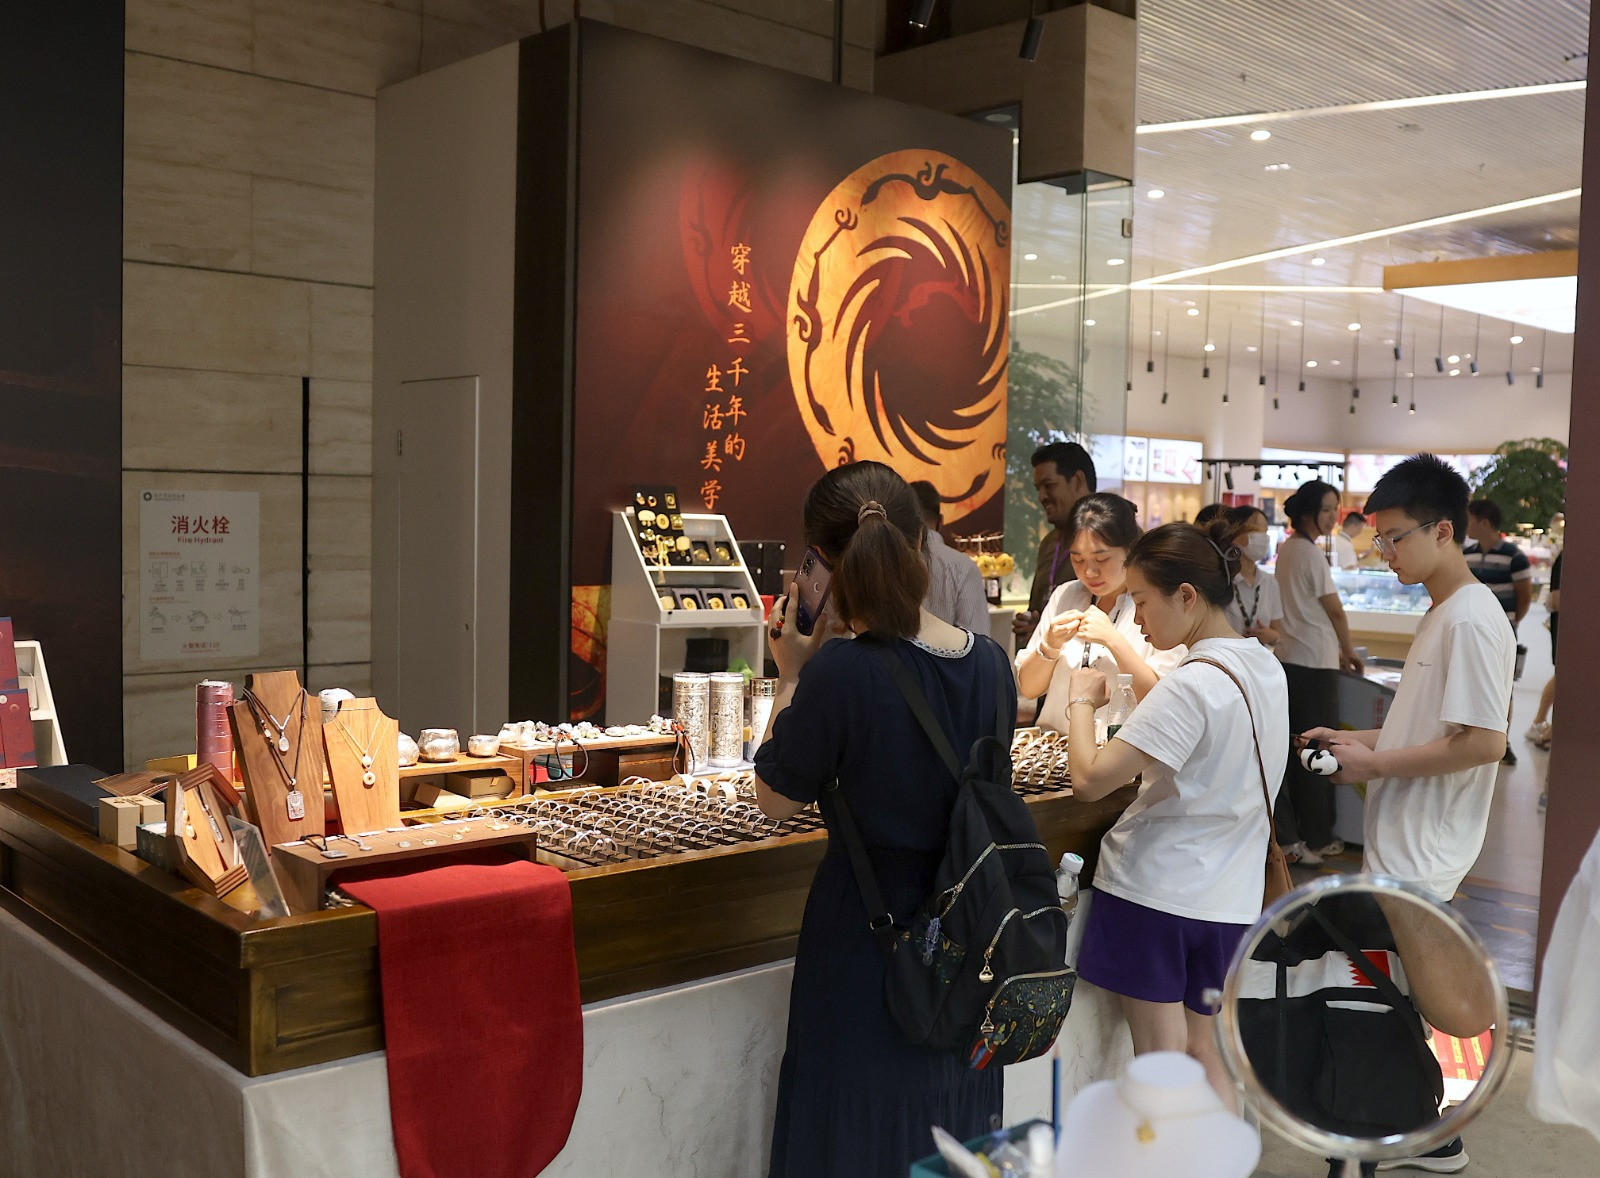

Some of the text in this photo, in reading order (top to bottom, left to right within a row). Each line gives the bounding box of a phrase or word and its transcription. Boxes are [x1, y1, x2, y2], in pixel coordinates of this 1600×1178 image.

[724, 242, 752, 461] 穿越三千年的
[700, 363, 725, 510] 生活美学
[171, 515, 230, 534] 消火栓
